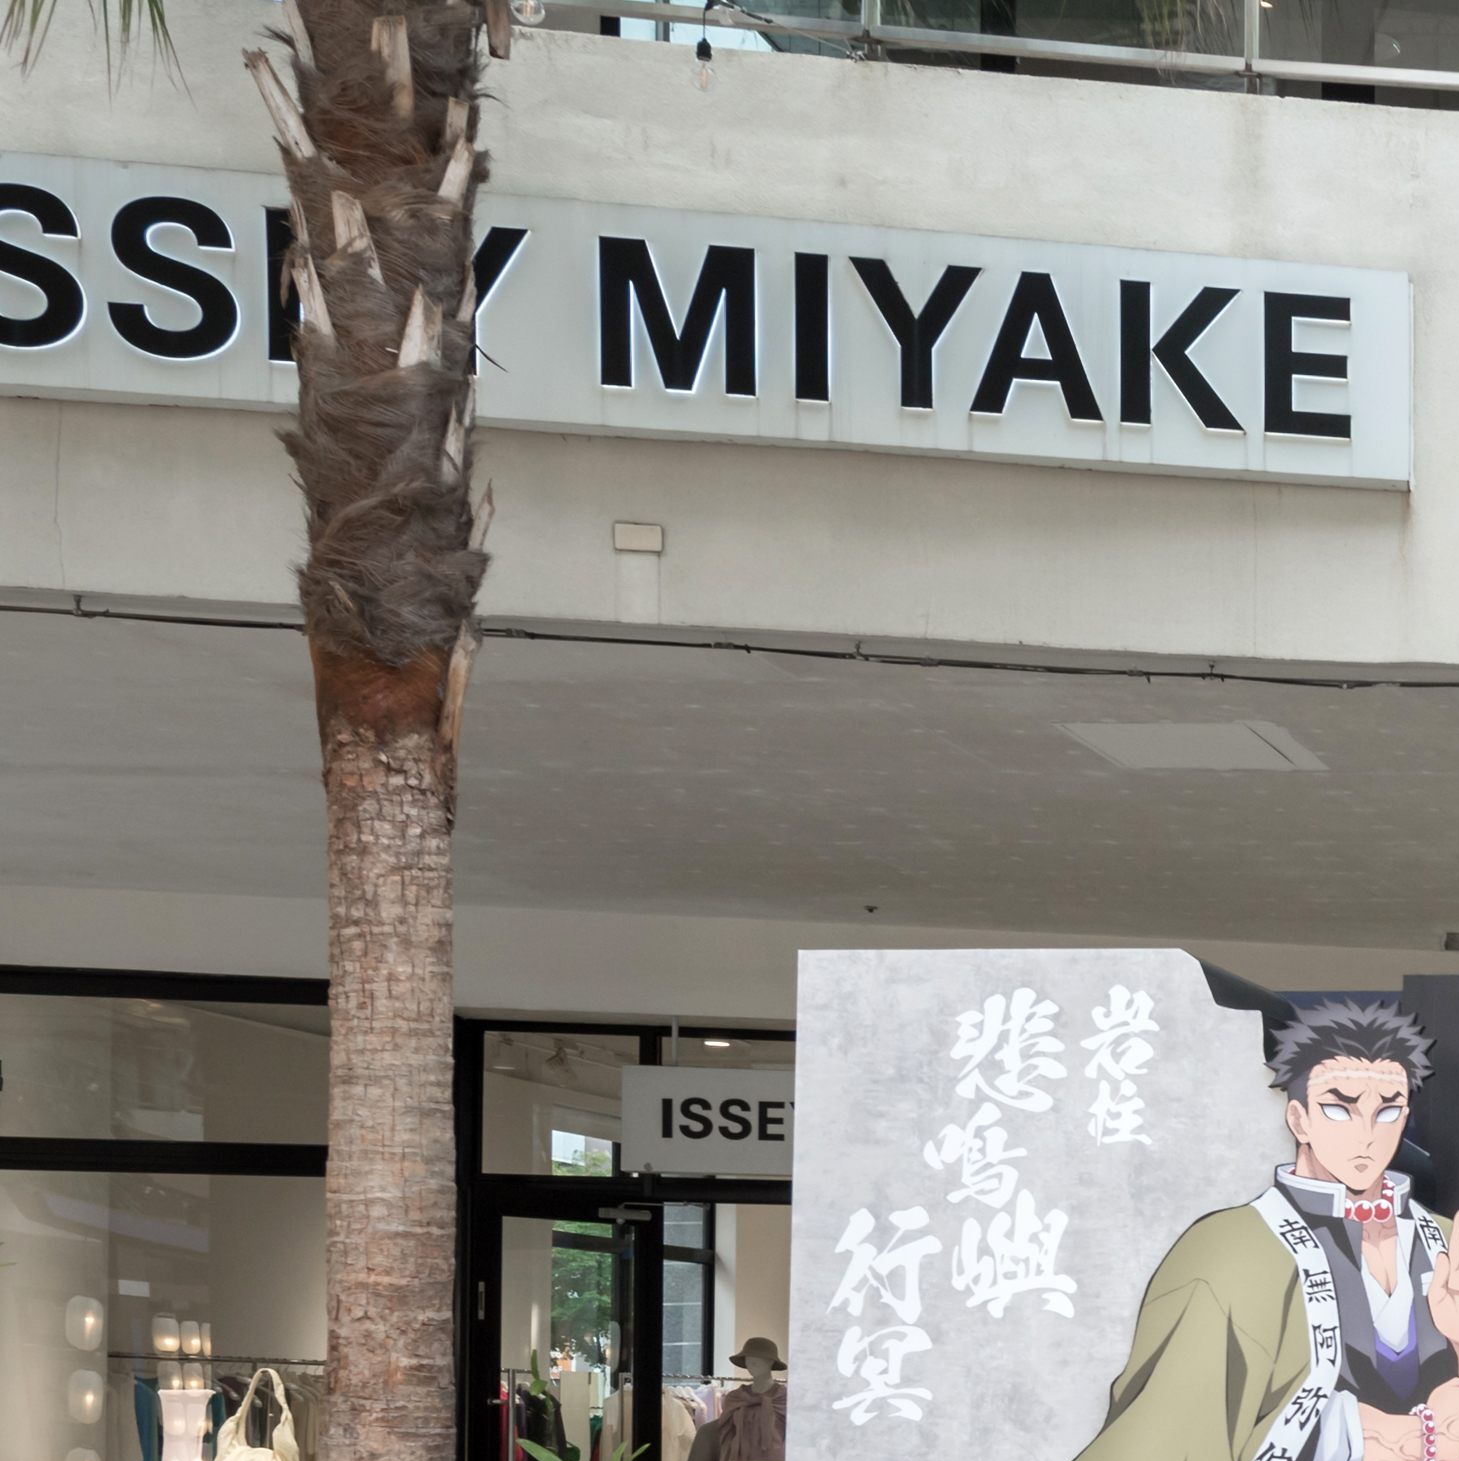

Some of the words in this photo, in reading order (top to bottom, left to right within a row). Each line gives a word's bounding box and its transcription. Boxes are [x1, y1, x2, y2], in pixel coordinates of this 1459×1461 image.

[598, 235, 1352, 439] MIYAKE
[662, 1097, 795, 1141] ISSE
[1081, 985, 1160, 1146] 岩柱
[825, 1206, 943, 1426] 行冥
